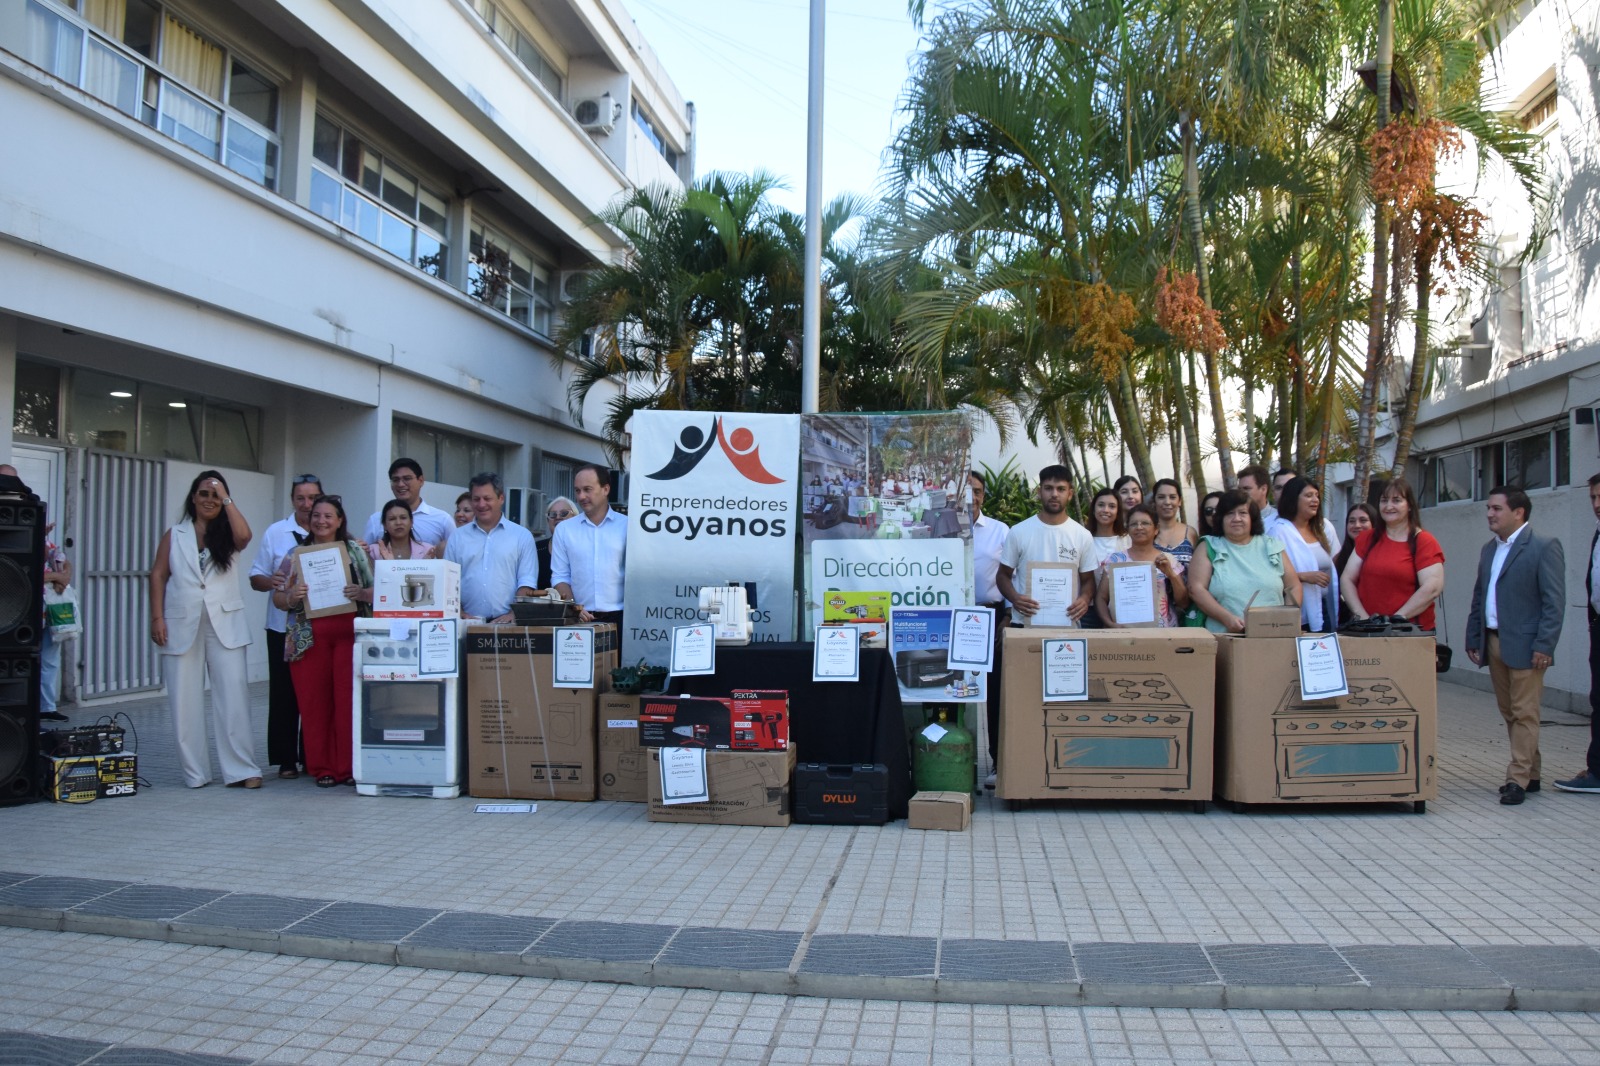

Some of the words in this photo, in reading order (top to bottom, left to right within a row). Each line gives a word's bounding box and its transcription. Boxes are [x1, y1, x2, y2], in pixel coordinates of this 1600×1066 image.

[640, 493, 788, 511] Emprendedores
[639, 509, 787, 541] Goyanos
[824, 557, 922, 577] Dirección
[926, 556, 953, 577] de
[630, 628, 669, 642] TASA
[477, 638, 536, 649] SMARTLIFE
[1099, 653, 1156, 661] INDUSTRIALES
[644, 703, 677, 714] OMAHA
[105, 784, 135, 795] SKP
[823, 794, 857, 804] DYLLU
